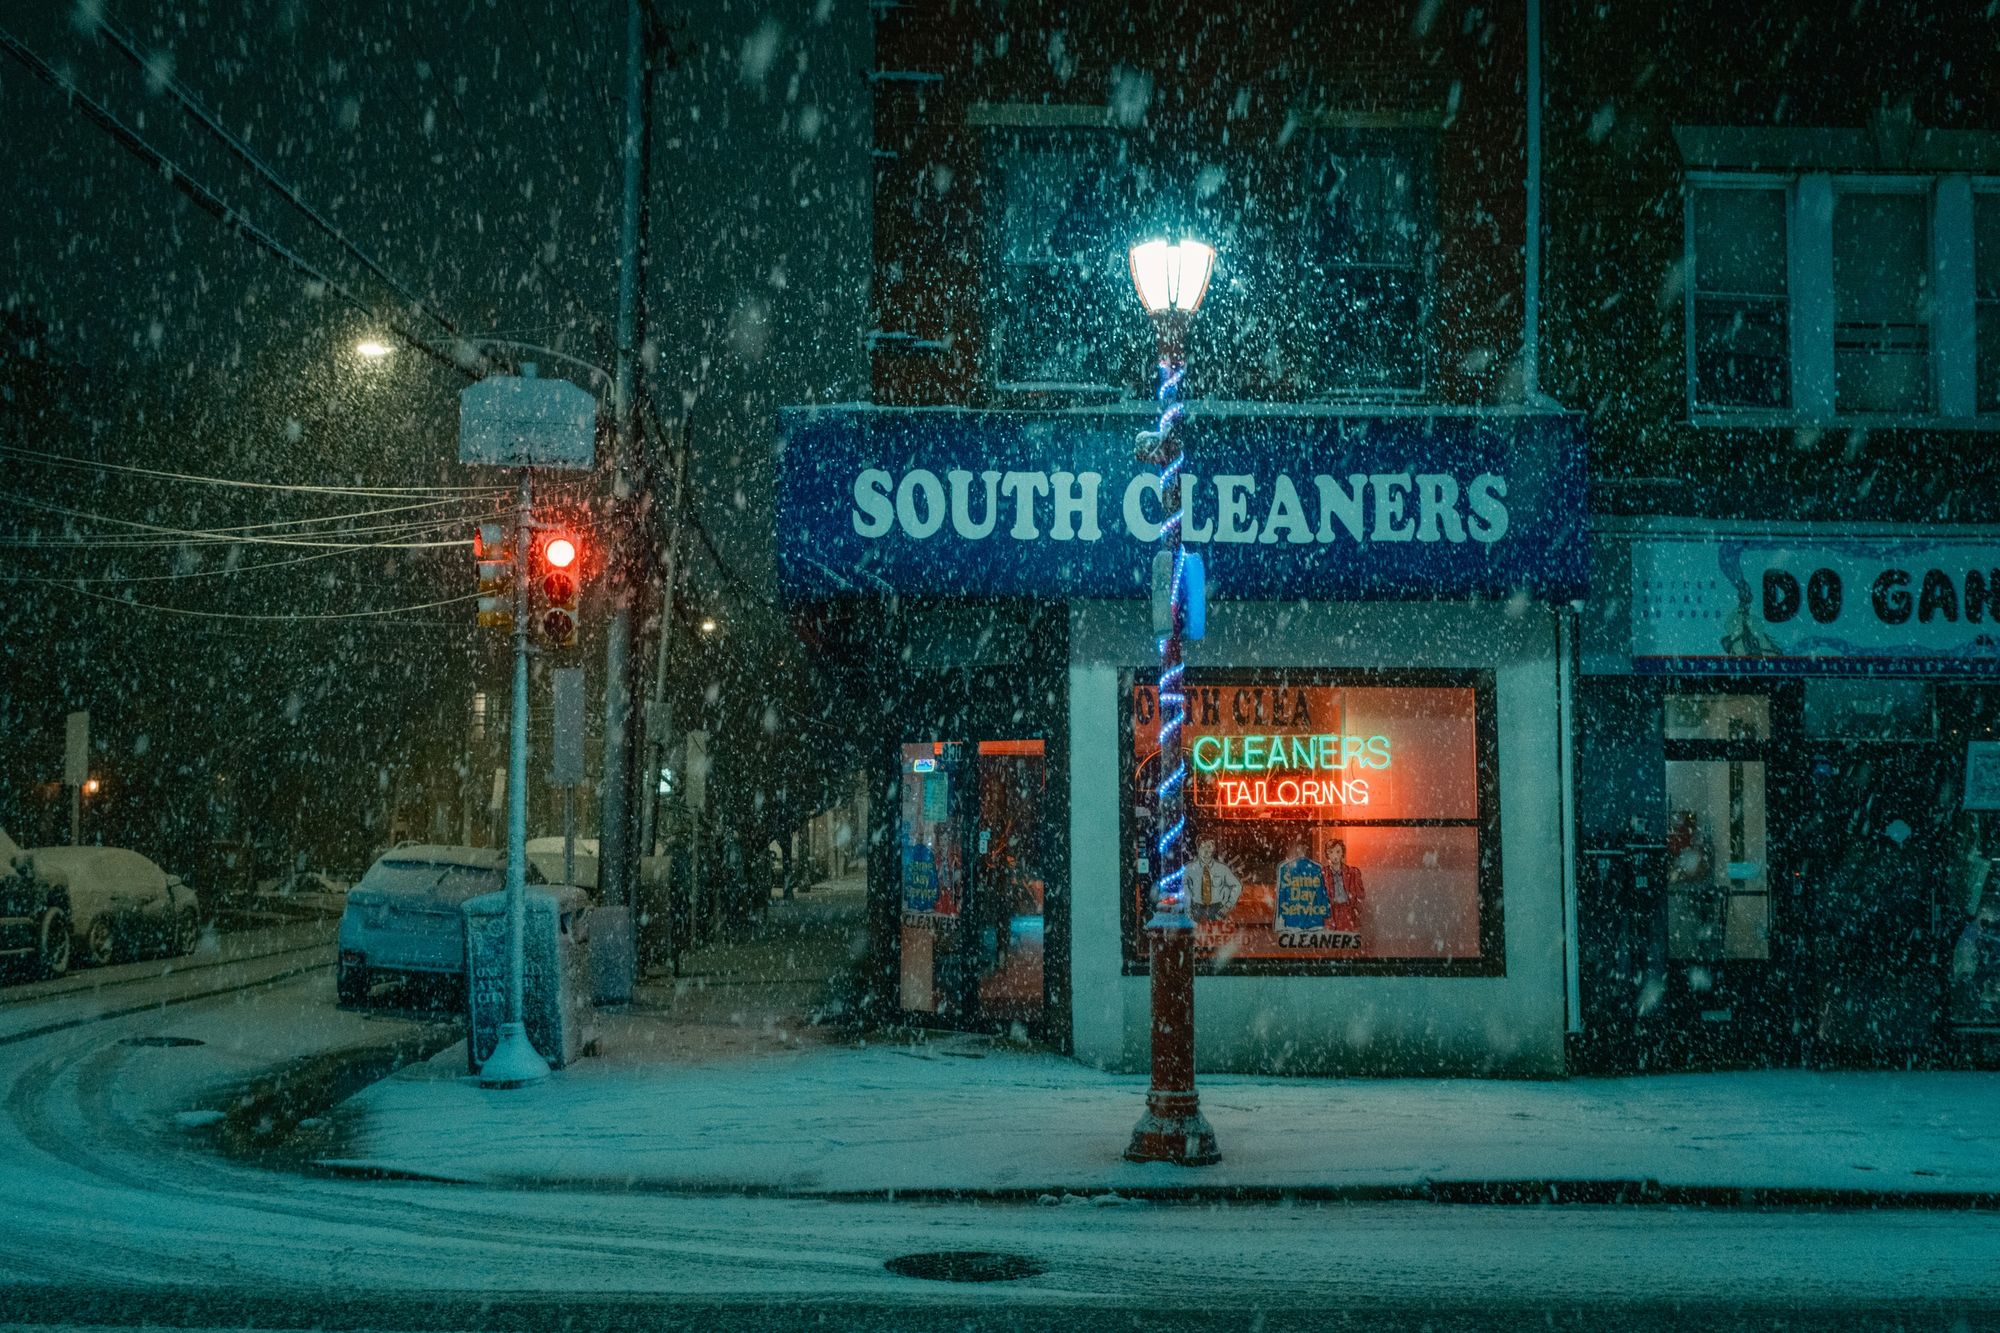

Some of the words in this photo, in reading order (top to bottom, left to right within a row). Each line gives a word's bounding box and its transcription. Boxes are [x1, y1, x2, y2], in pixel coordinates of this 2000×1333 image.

[852, 469, 1102, 541] SOUTH
[1123, 473, 1510, 545] CLEANERS
[1762, 567, 1842, 624] DO
[1136, 688, 1221, 726] OTH
[1193, 735, 1392, 770] CLEANERS
[1283, 874, 1321, 888] Same
[1290, 888, 1316, 903] Day
[1281, 902, 1327, 915] Service
[1279, 933, 1362, 949] CLEANERS
